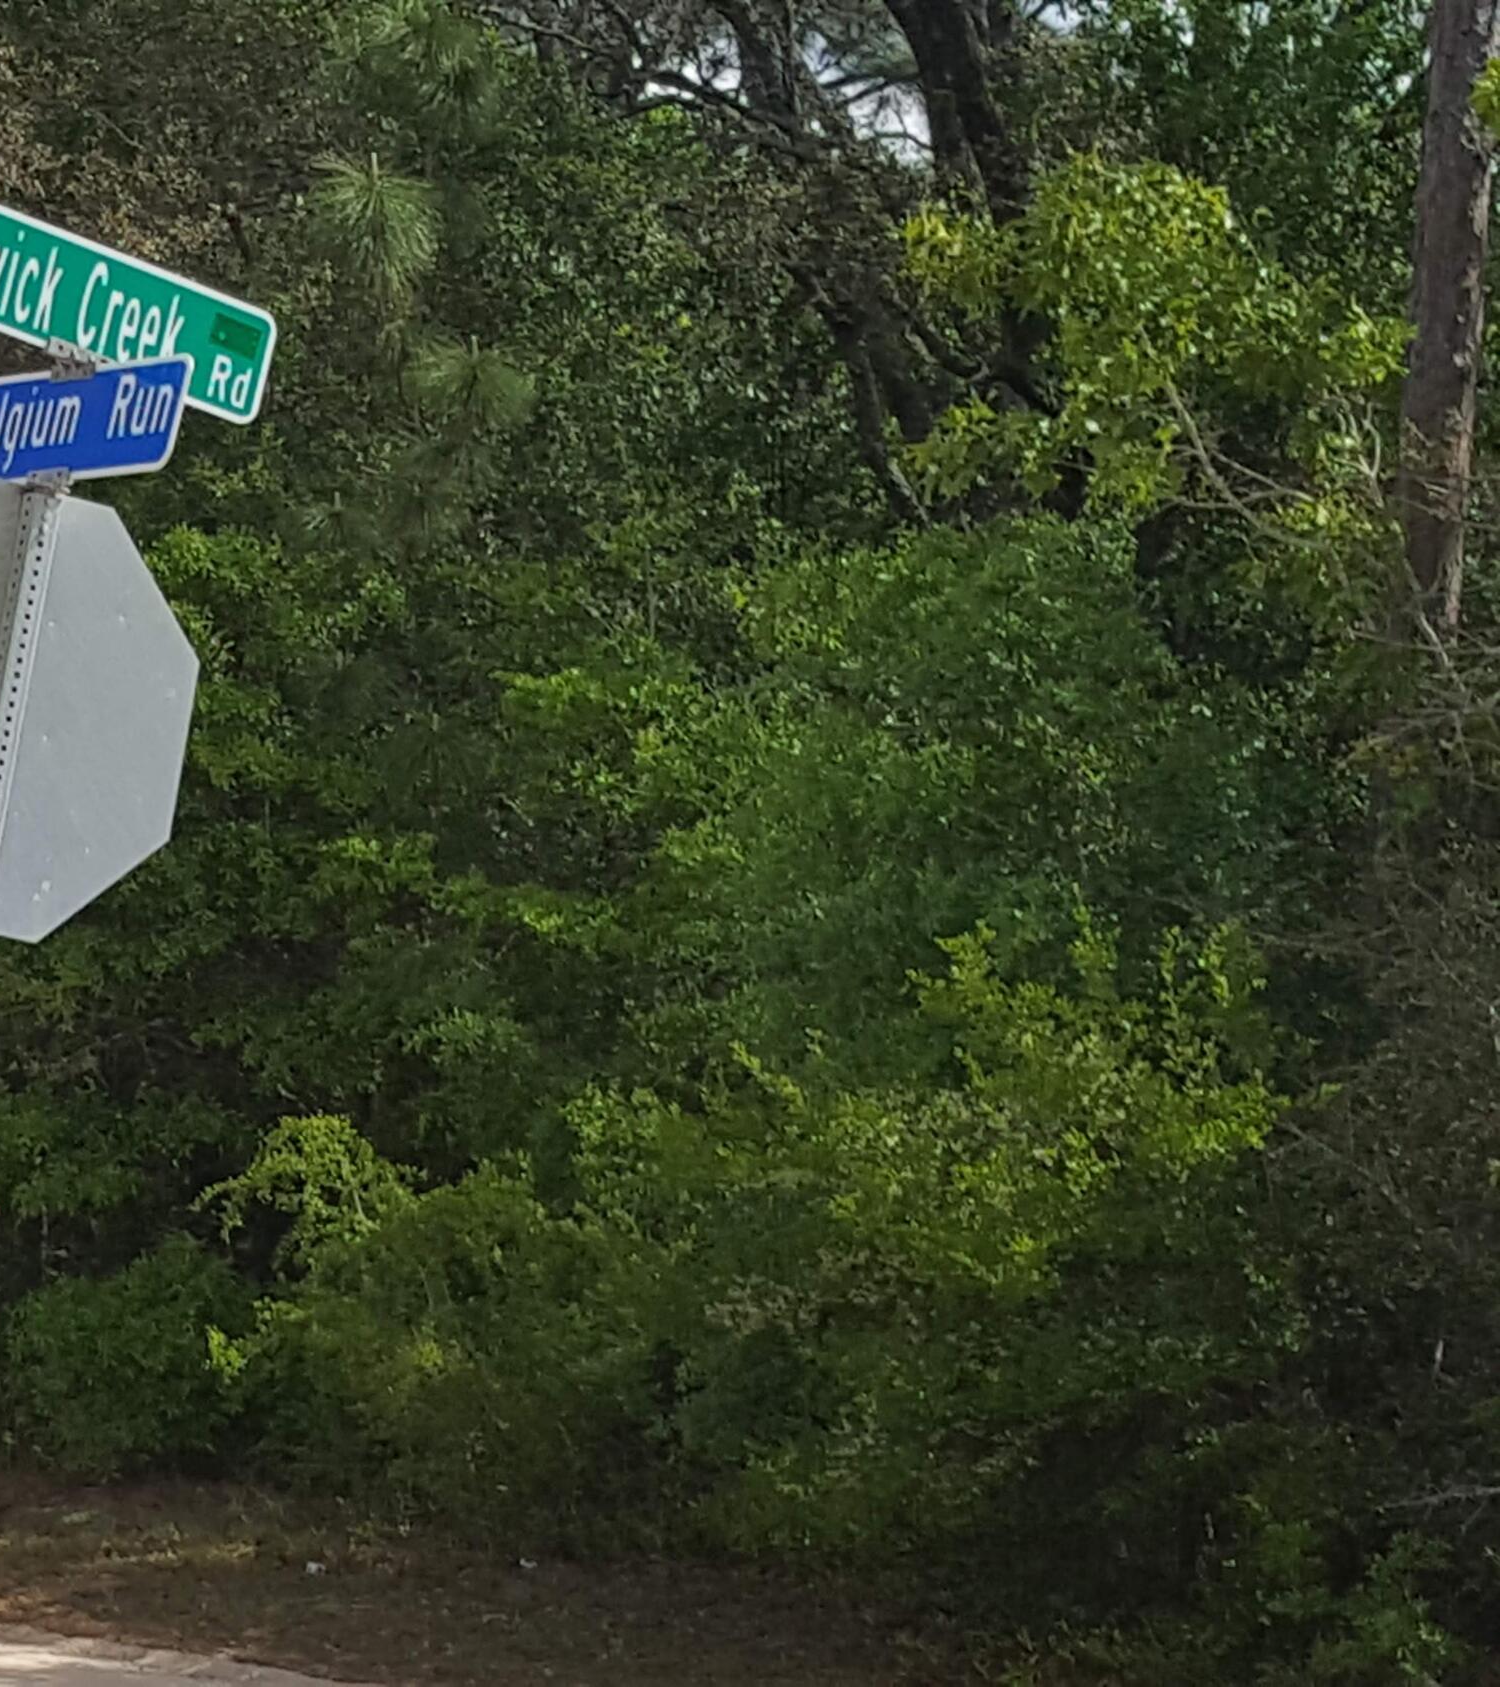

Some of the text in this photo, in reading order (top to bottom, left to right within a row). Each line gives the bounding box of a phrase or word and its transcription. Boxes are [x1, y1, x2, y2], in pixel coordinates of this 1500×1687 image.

[76, 262, 185, 363] Creek
[206, 353, 253, 410] Rd
[106, 374, 175, 440] Run
